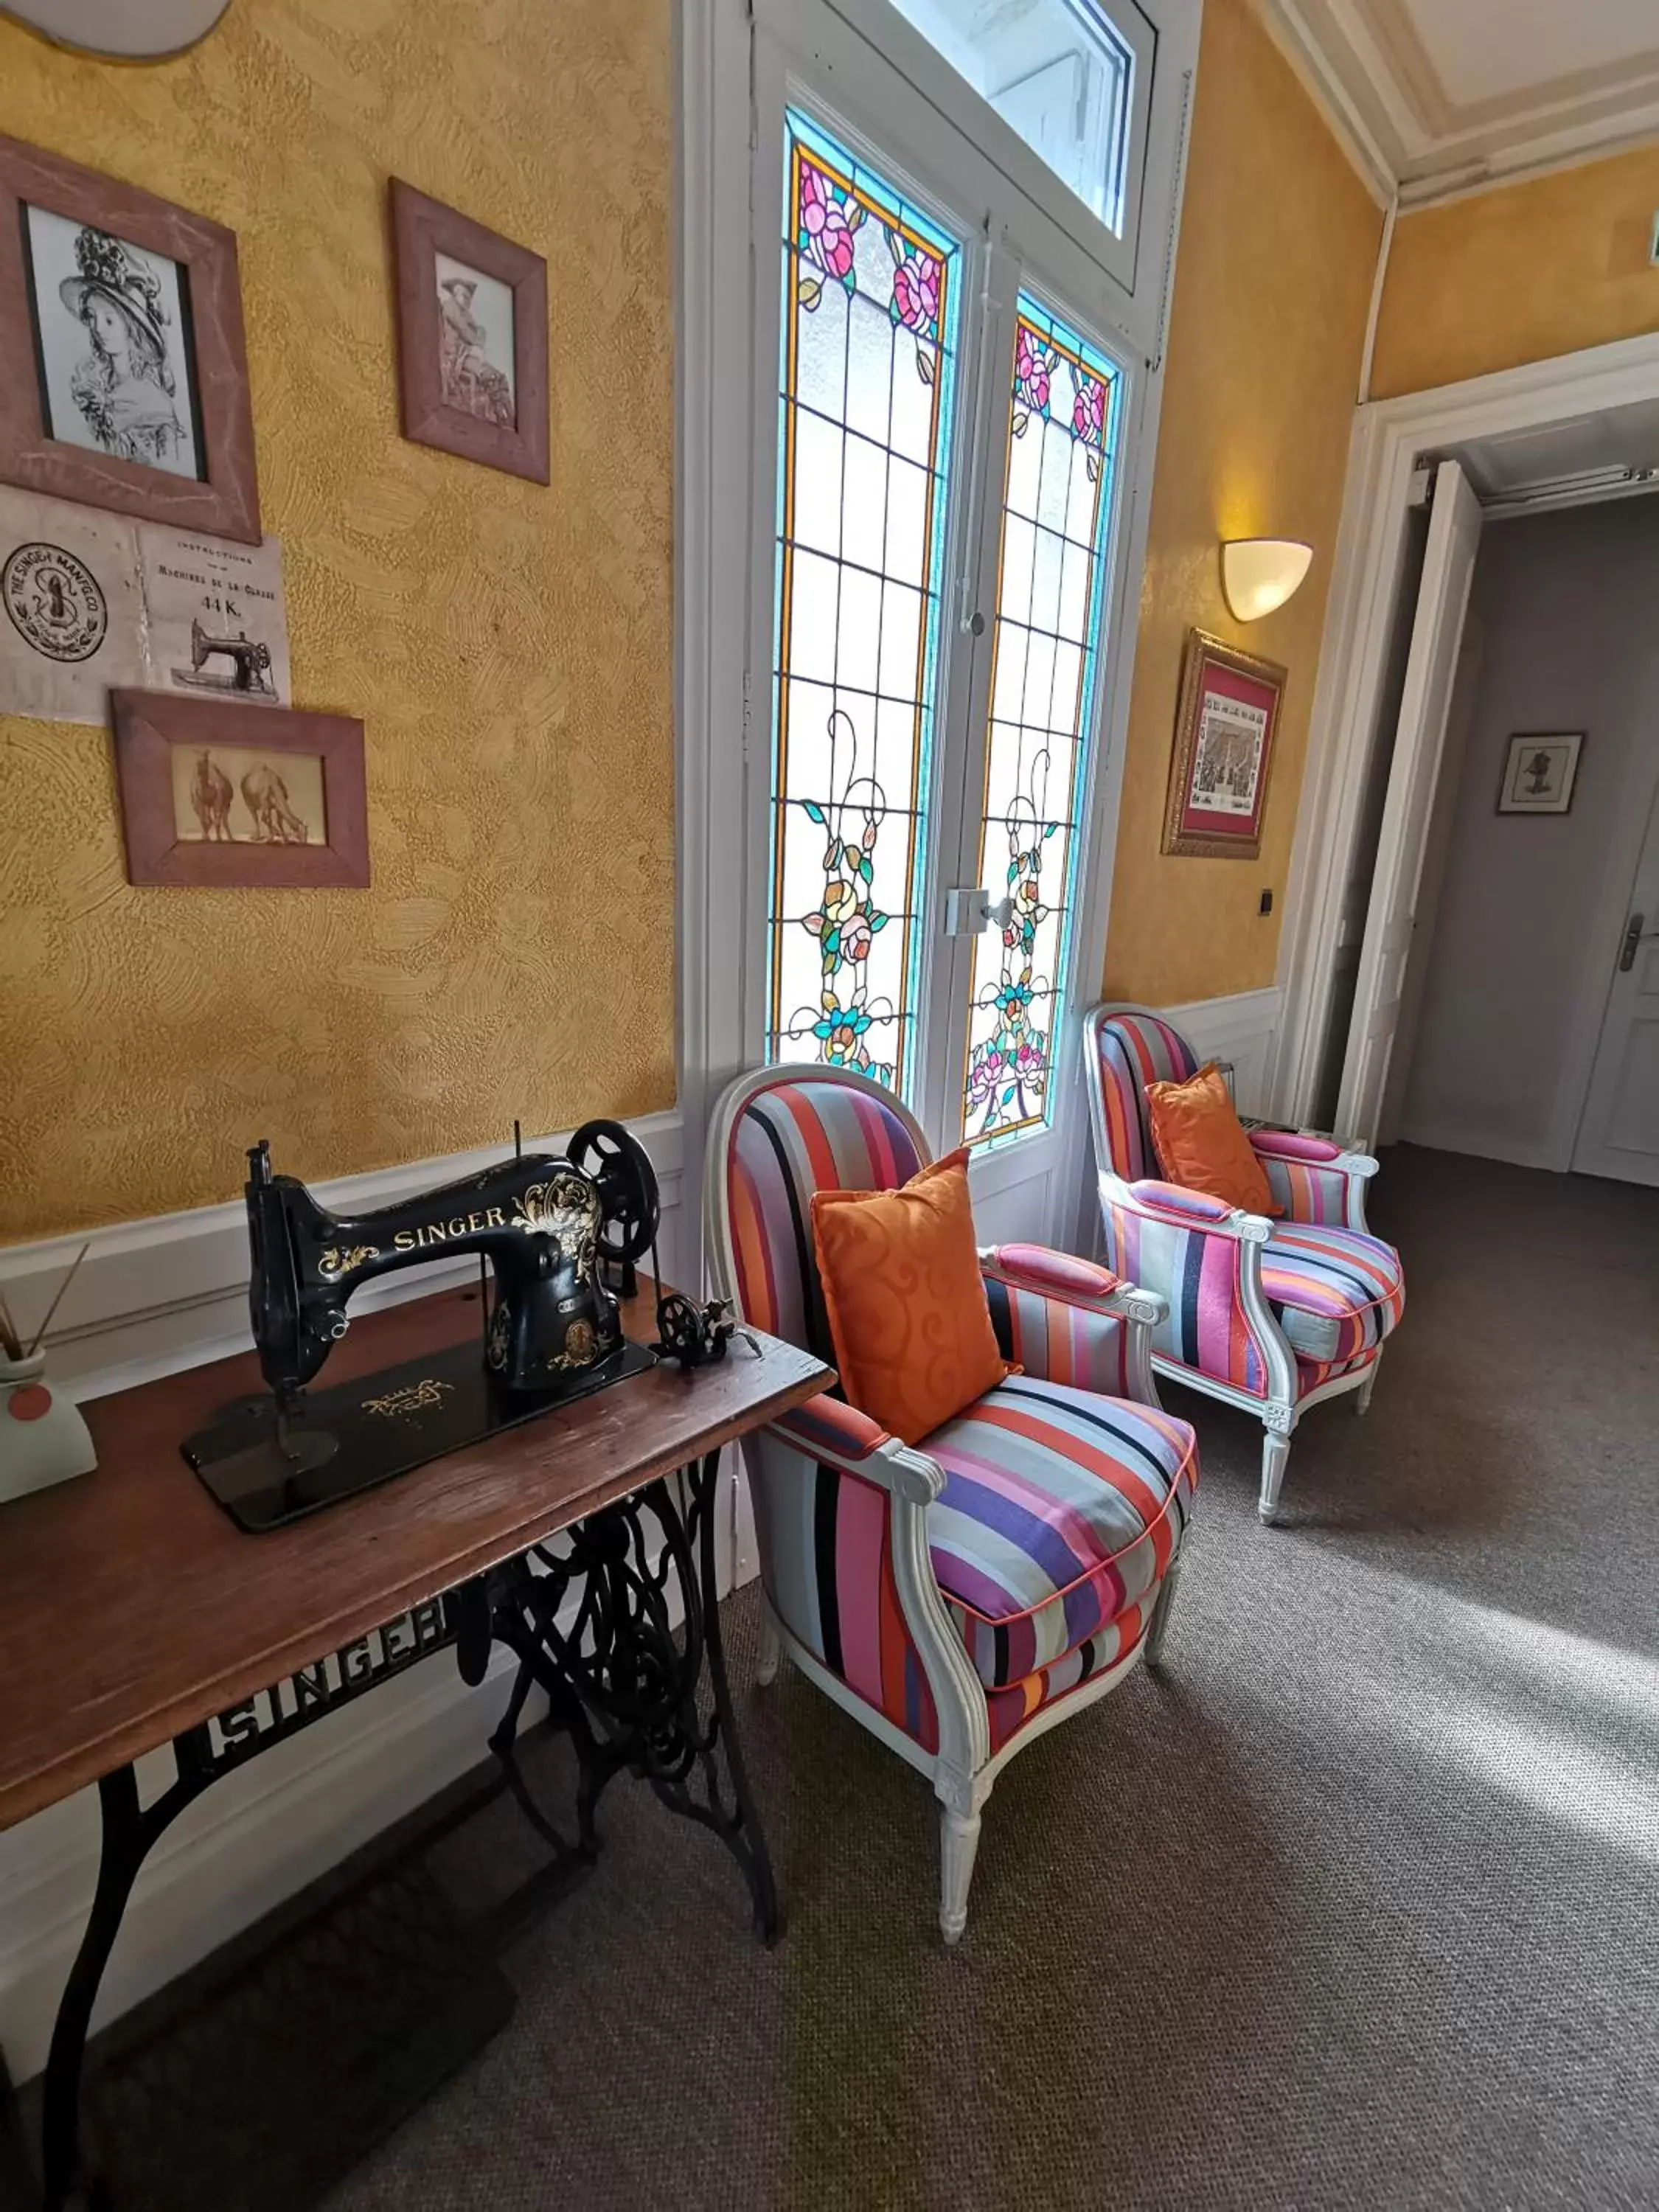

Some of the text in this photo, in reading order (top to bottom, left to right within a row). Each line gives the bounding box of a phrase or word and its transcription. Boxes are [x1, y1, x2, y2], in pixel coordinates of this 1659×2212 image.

[11, 574, 24, 595] THE
[394, 1206, 506, 1252] SINGER
[220, 1601, 443, 1749] SINGER
